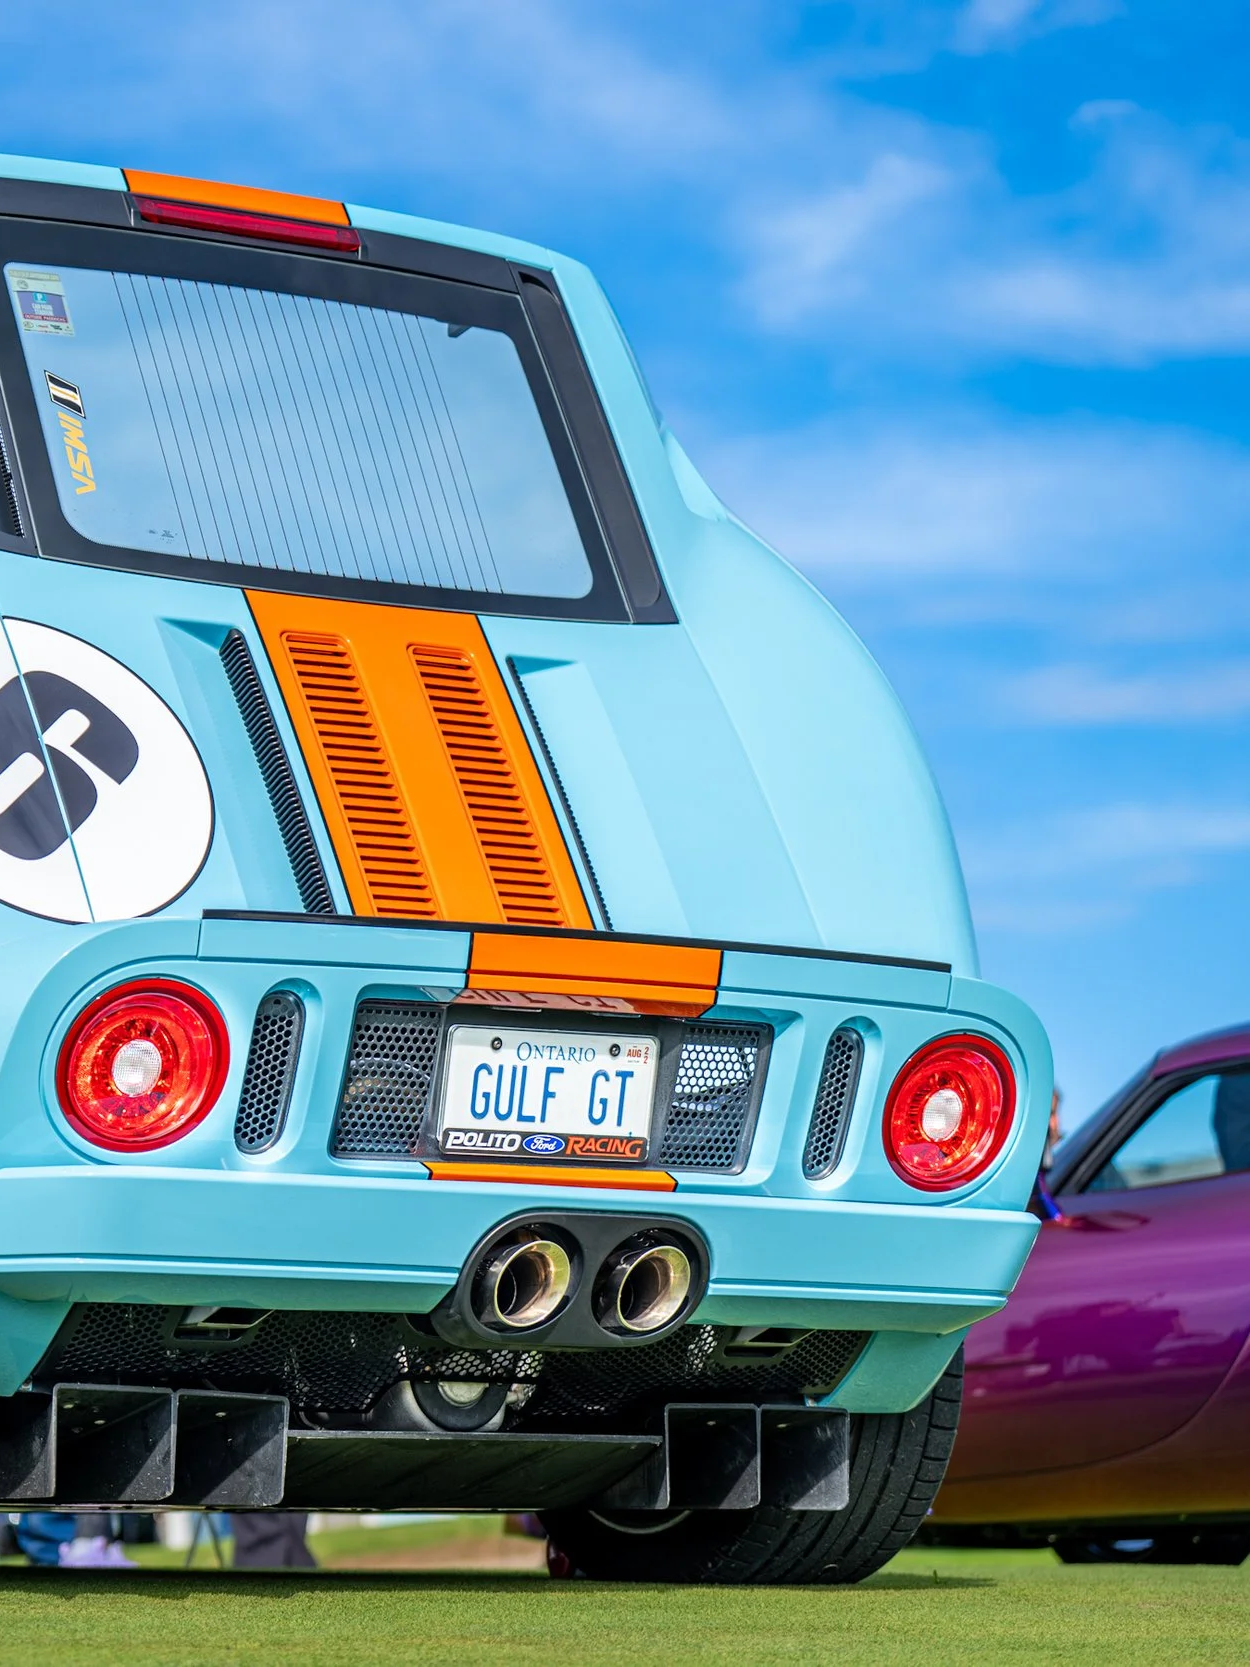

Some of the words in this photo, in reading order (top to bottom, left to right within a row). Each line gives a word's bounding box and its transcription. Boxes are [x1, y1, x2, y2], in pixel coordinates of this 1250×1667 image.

[57, 411, 96, 495] IMSA
[626, 1048, 641, 1058] AUG
[470, 1062, 564, 1123] GULF
[588, 1069, 635, 1127] GT
[445, 1131, 522, 1152] POLITO
[530, 1136, 557, 1151] Ford
[565, 1135, 644, 1159] RACING
